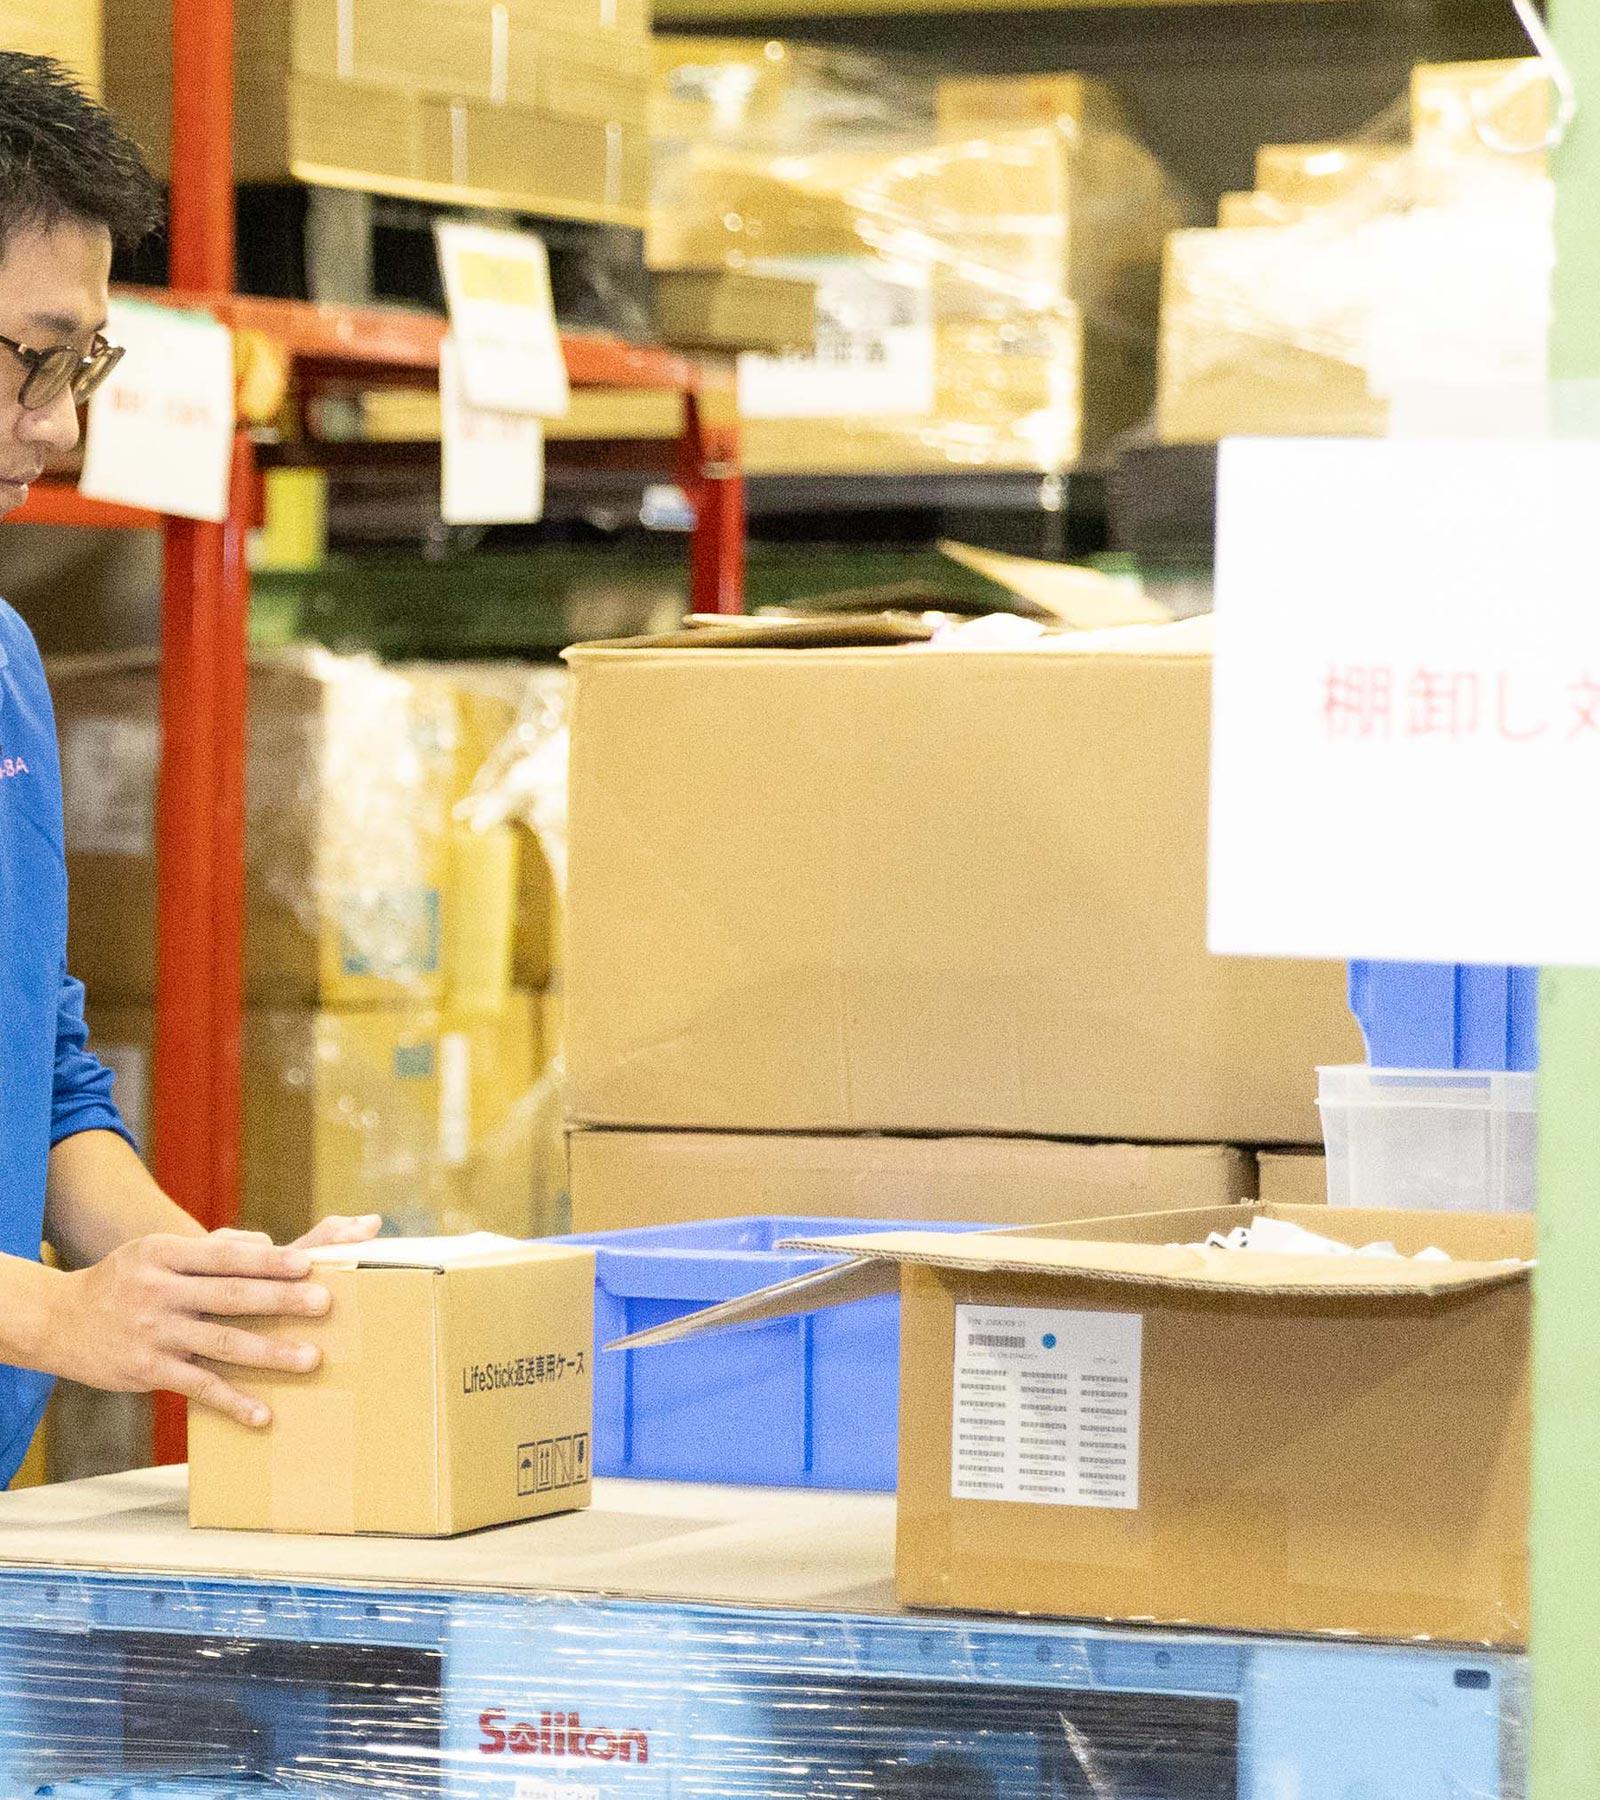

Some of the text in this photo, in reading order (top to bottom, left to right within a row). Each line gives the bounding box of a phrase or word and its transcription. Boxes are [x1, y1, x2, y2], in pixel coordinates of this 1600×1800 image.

[462, 1351, 585, 1394] LifeStick返送専用ケース
[478, 1707, 649, 1764] Soliton
